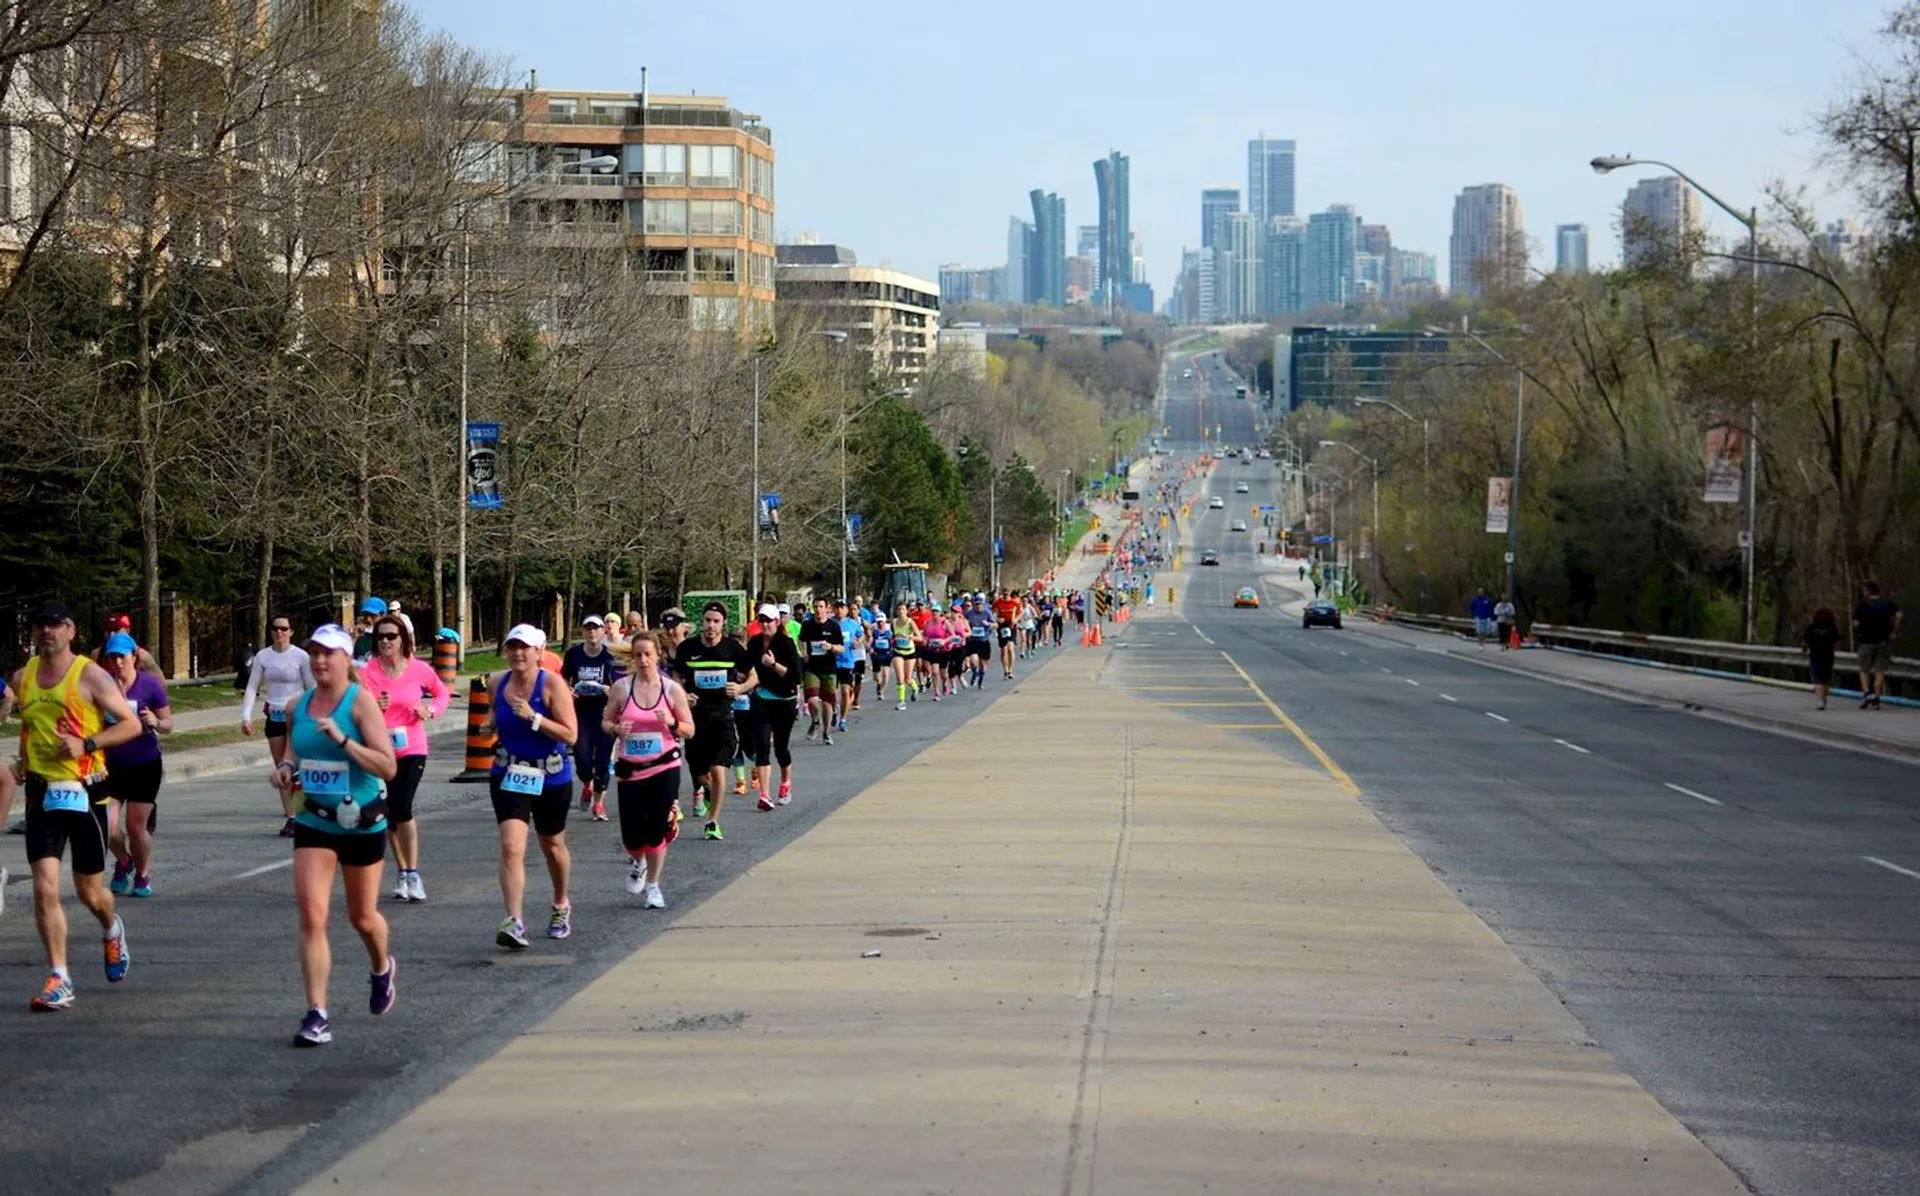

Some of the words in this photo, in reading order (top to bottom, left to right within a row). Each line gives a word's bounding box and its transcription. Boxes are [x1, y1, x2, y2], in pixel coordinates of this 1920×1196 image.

[631, 739, 653, 749] 387
[303, 770, 341, 784] 1007
[506, 771, 536, 786] 1021
